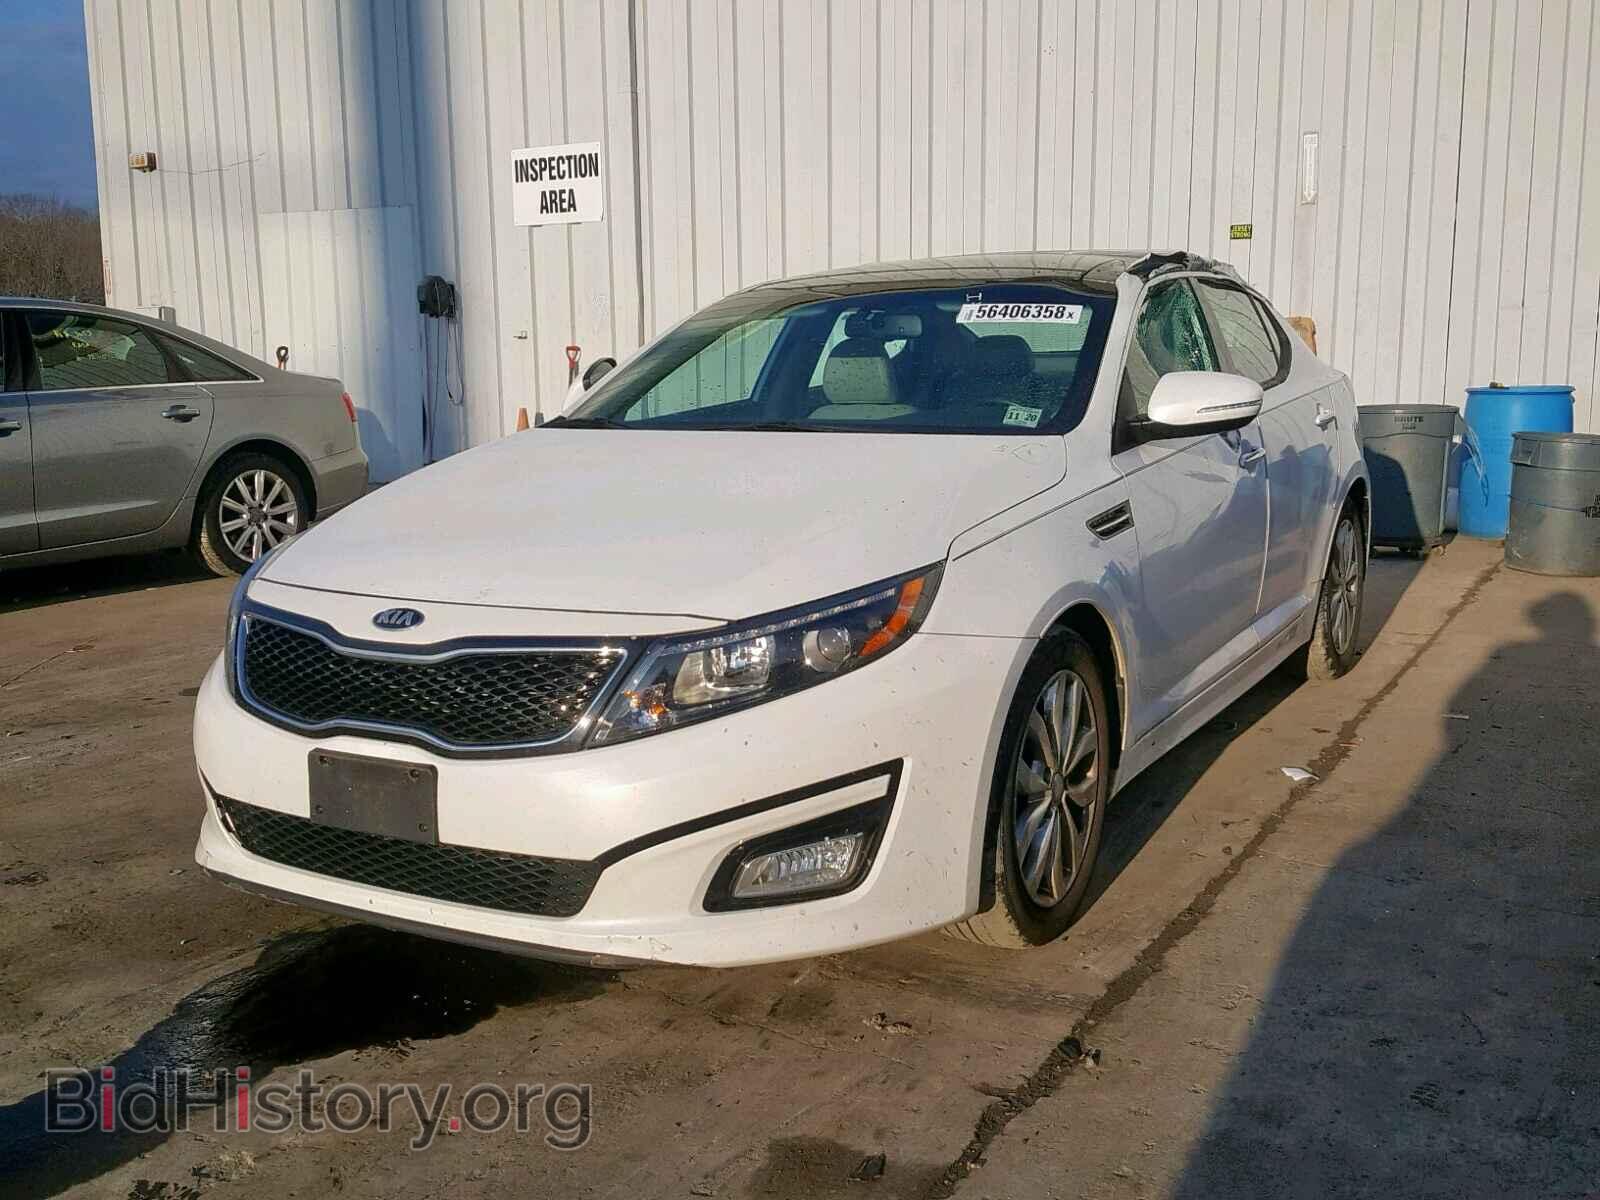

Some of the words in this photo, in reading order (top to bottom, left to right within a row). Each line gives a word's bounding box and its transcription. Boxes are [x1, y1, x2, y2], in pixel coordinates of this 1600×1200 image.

[514, 153, 599, 183] INSPECTION
[540, 188, 577, 214] AREA
[376, 610, 415, 625] KIA
